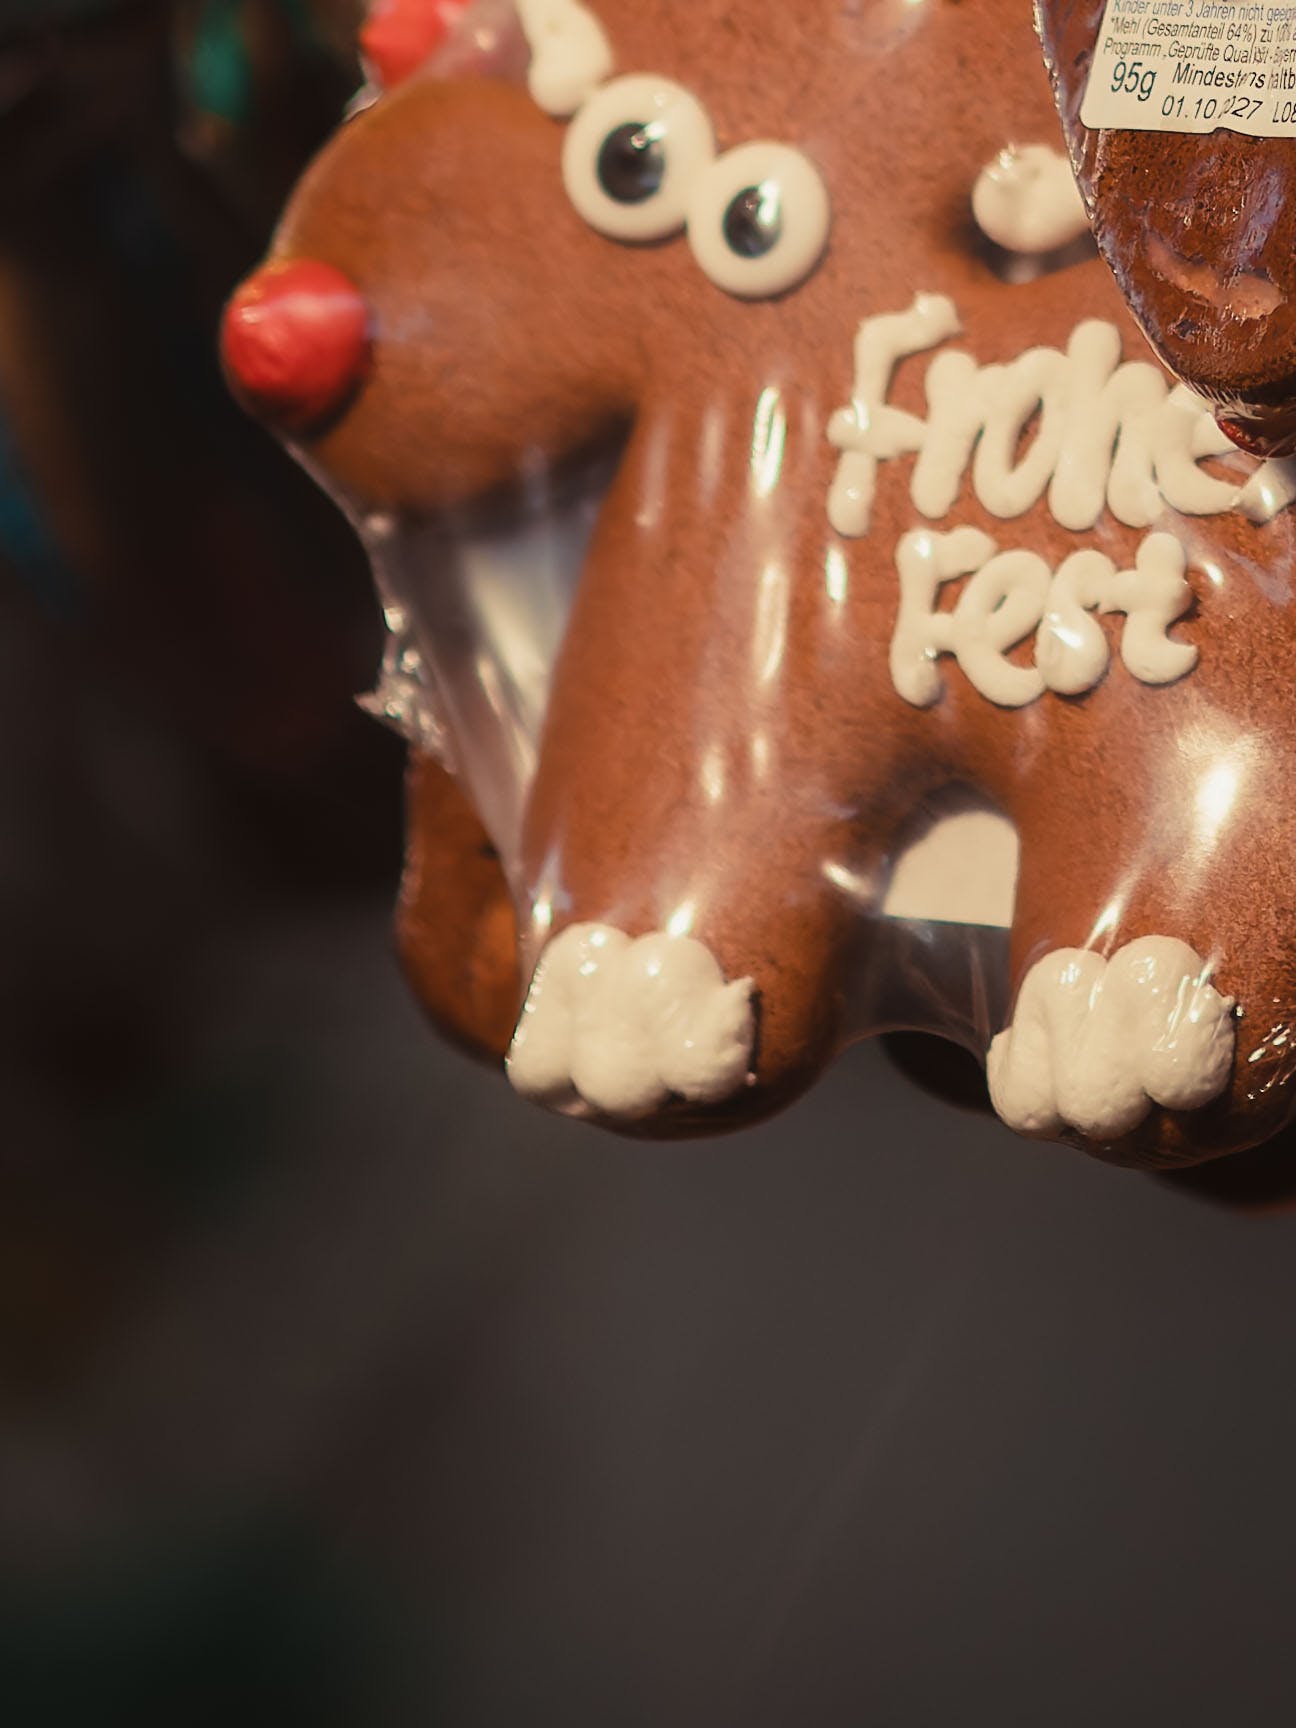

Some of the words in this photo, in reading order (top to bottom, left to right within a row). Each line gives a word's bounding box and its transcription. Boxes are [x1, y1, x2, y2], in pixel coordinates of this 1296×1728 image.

[1152, 0, 1185, 18] unter
[1185, 0, 1195, 19] 3
[1195, 1, 1236, 21] Jahren
[1238, 3, 1265, 22] nicht
[1142, 17, 1225, 41] (Gesamtanteil
[1104, 37, 1162, 60] Programm
[1110, 61, 1158, 102] 95g
[888, 525, 1200, 709] Fest
